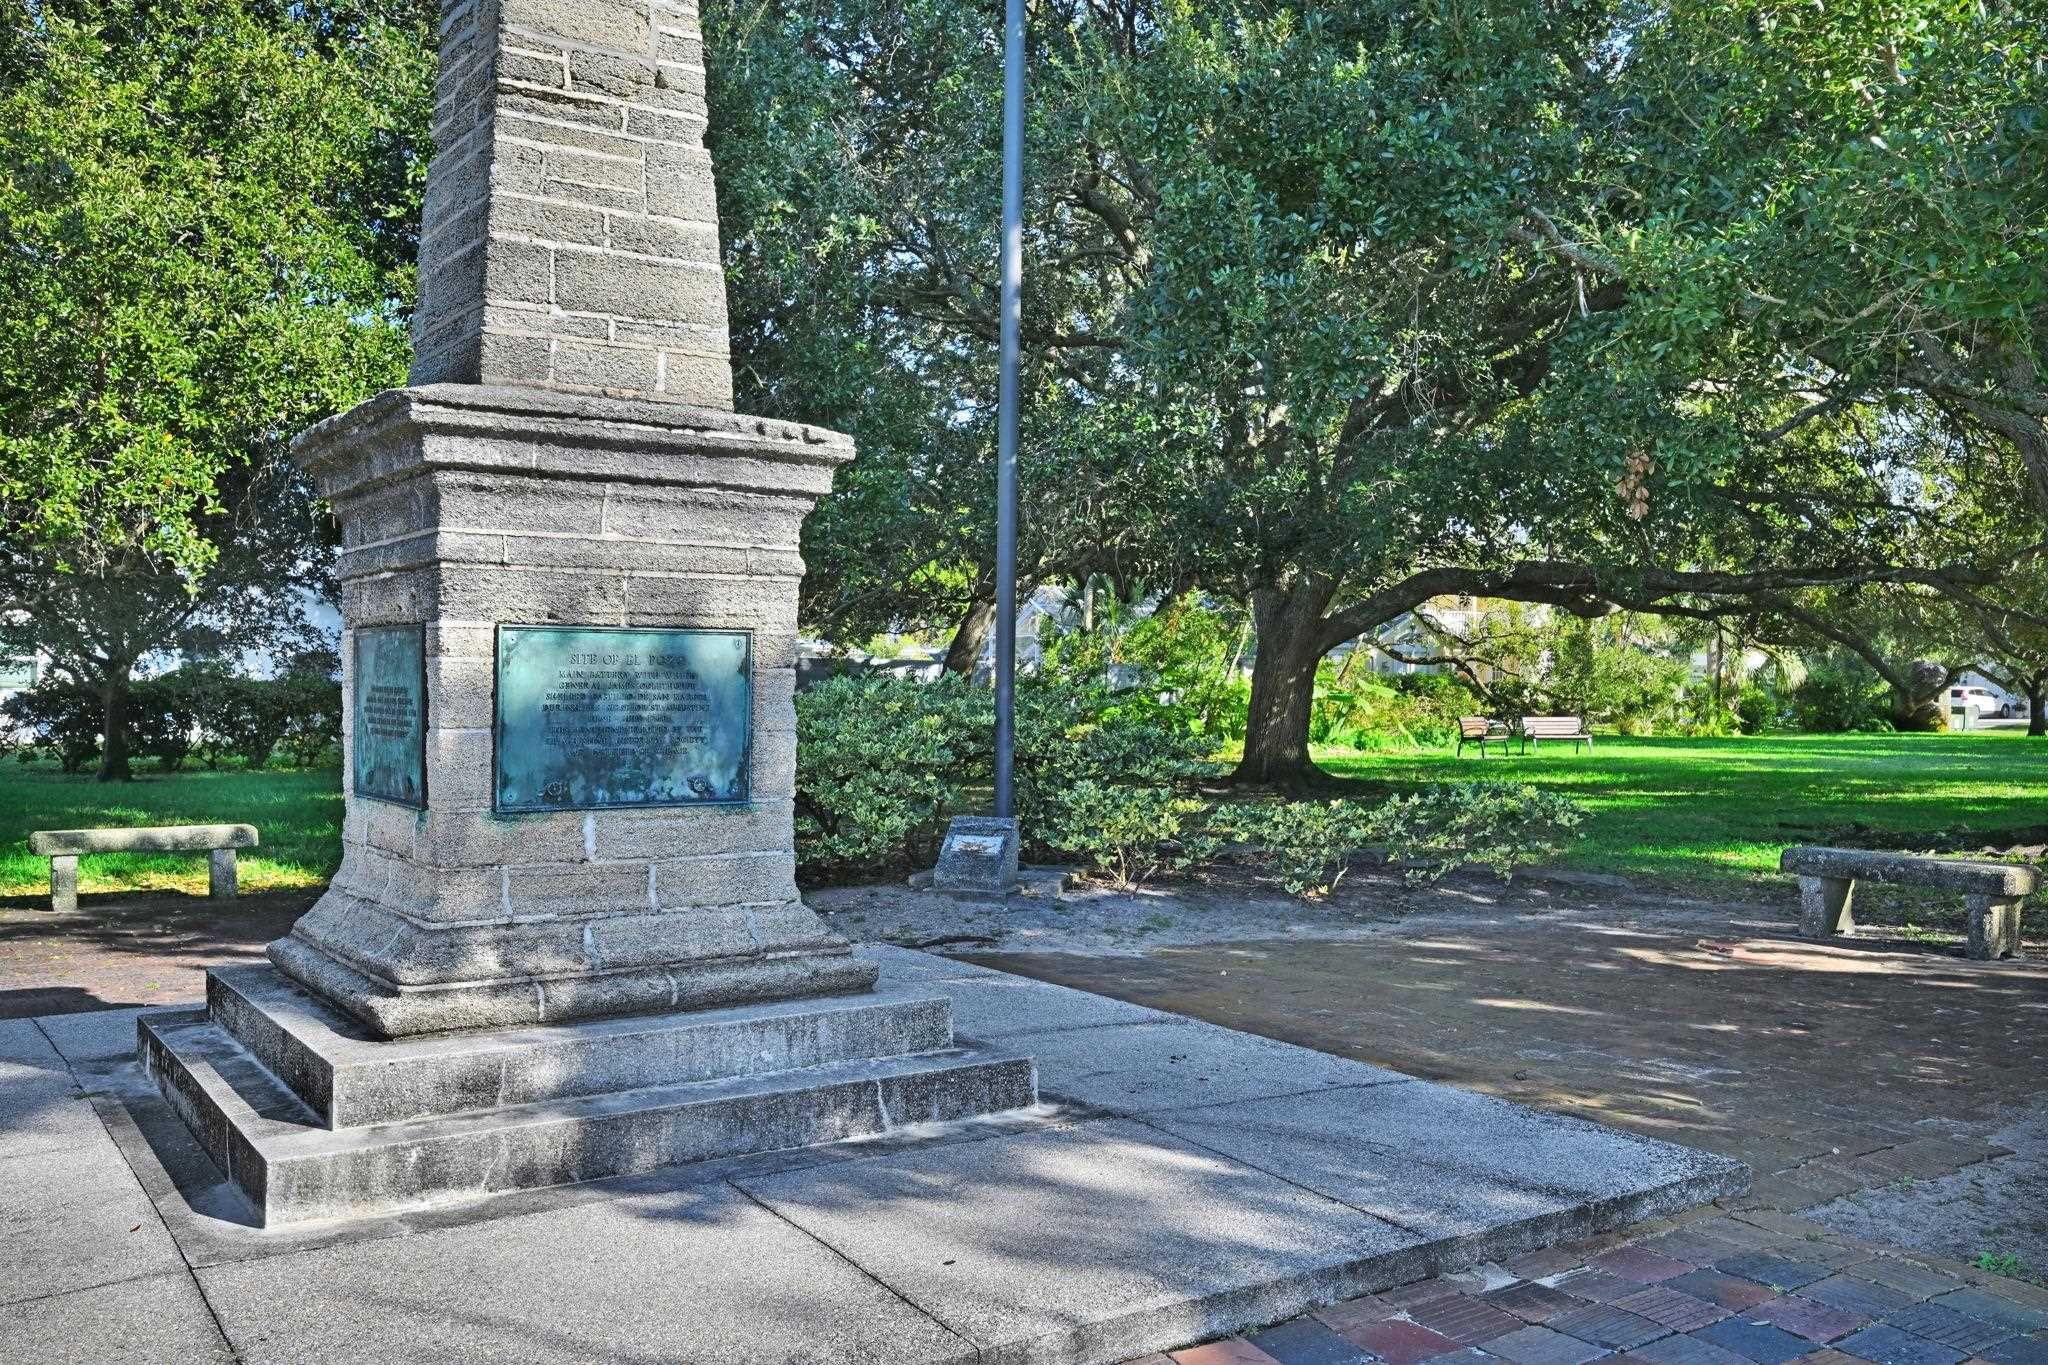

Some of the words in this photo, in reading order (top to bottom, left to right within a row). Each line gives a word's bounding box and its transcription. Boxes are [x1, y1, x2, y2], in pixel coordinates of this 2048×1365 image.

[570, 653, 597, 665] SITE
[602, 654, 619, 666] OF
[626, 654, 641, 666] EL
[558, 682, 600, 690] GENERAL
